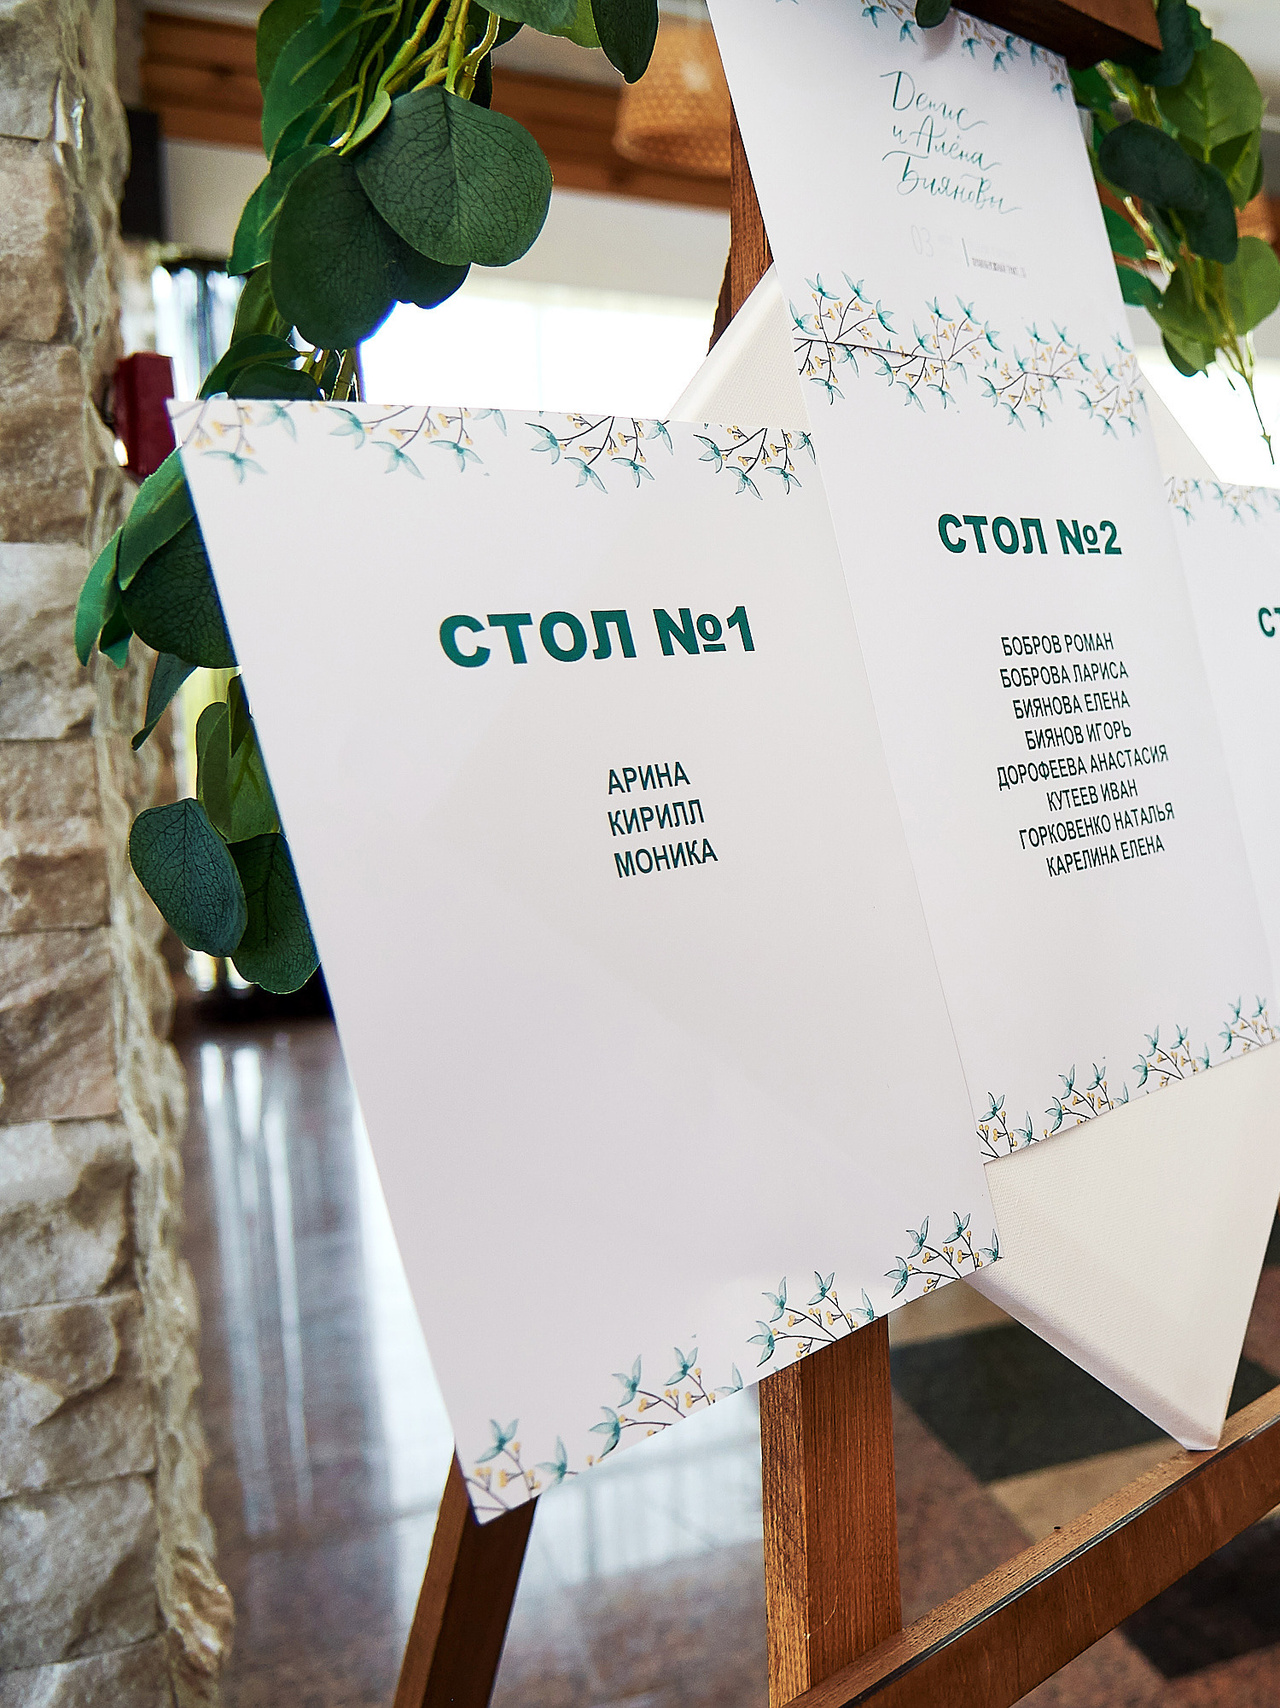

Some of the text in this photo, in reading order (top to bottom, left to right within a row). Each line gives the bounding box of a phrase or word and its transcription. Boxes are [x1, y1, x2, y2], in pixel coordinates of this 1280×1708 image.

[880, 71, 988, 130] Денис
[893, 115, 1001, 170] и Алёна
[938, 514, 1122, 555] СТОЛ №2
[439, 606, 755, 667] СТОЛ №1
[1001, 633, 1114, 656] БОБРОВ РОМАН
[1000, 661, 1128, 688] БОБРОВА ЛАРИСА
[1013, 691, 1130, 719] БИЯНОВА ЕЛЕНА
[1025, 720, 1132, 750] БИЯНОВ ИГОРЬ
[608, 761, 690, 794] АРИНА
[997, 744, 1168, 790] ДОРОФЕЕВА АНАСТАСИЯ
[1047, 779, 1138, 811] КУТЕЕВ ИВАН
[608, 799, 704, 836] КИРИЛЛ
[1019, 803, 1174, 849] ГОРКОВЕНКО НАТАЛЬЯ
[614, 838, 718, 878] МОНИКА
[1046, 835, 1164, 877] КАРЕЛИНА ЕЛЕНА
